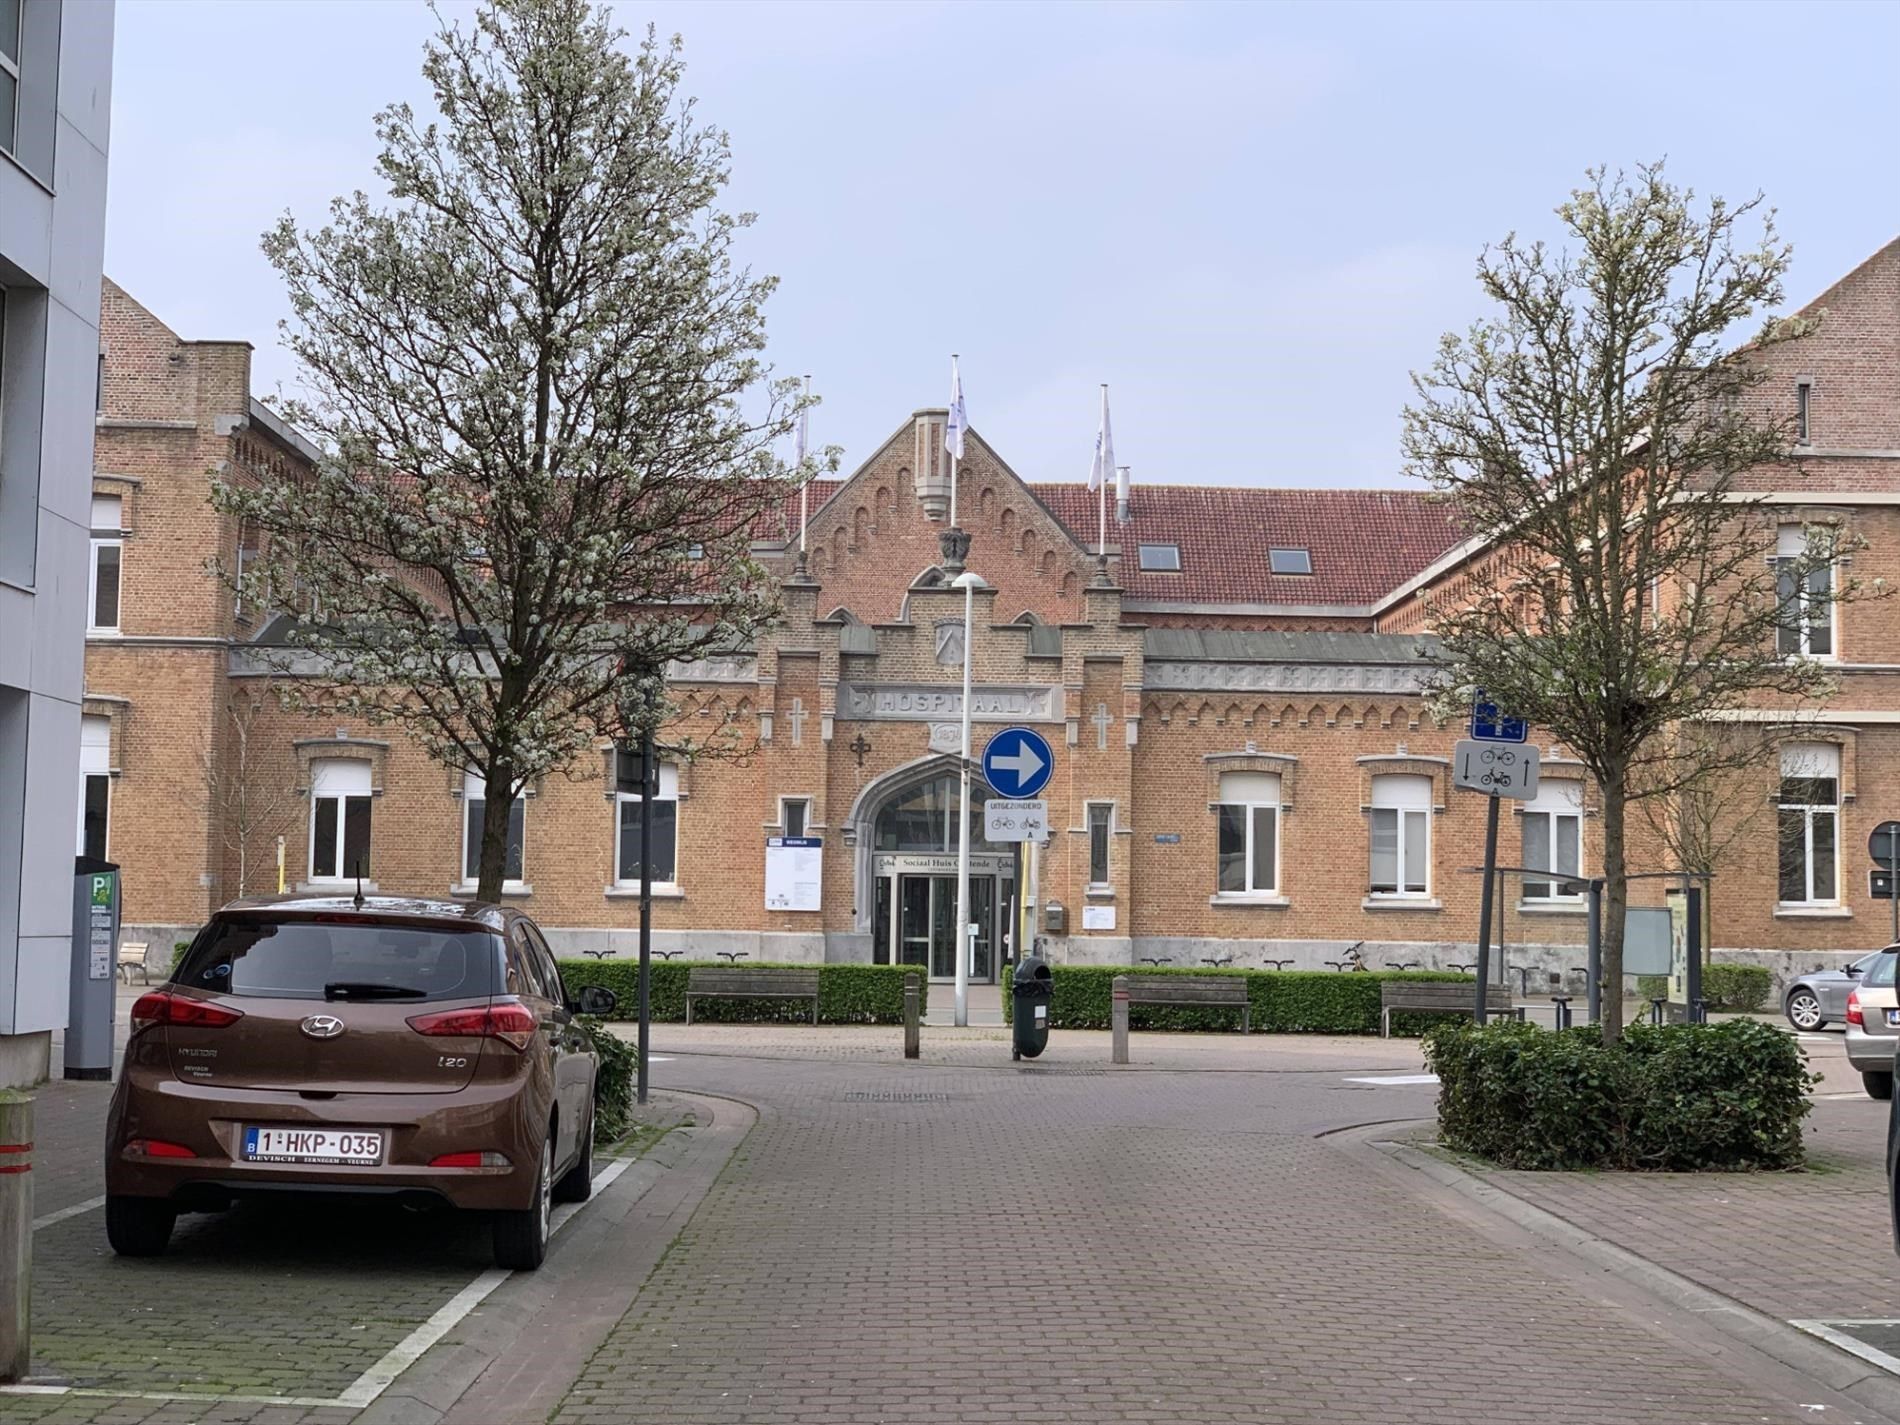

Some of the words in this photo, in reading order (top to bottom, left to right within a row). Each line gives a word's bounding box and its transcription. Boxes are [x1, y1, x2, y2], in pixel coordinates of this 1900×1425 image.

[1491, 787, 1499, 795] A
[990, 802, 1042, 810] UITGEZONDERD
[903, 859, 930, 867] Sociaal
[932, 859, 951, 867] Huis
[953, 859, 990, 868] Otende
[93, 877, 105, 896] P
[178, 1047, 218, 1057] HYUNDAI
[247, 1142, 256, 1153] B
[347, 1158, 374, 1166] VEURNE
